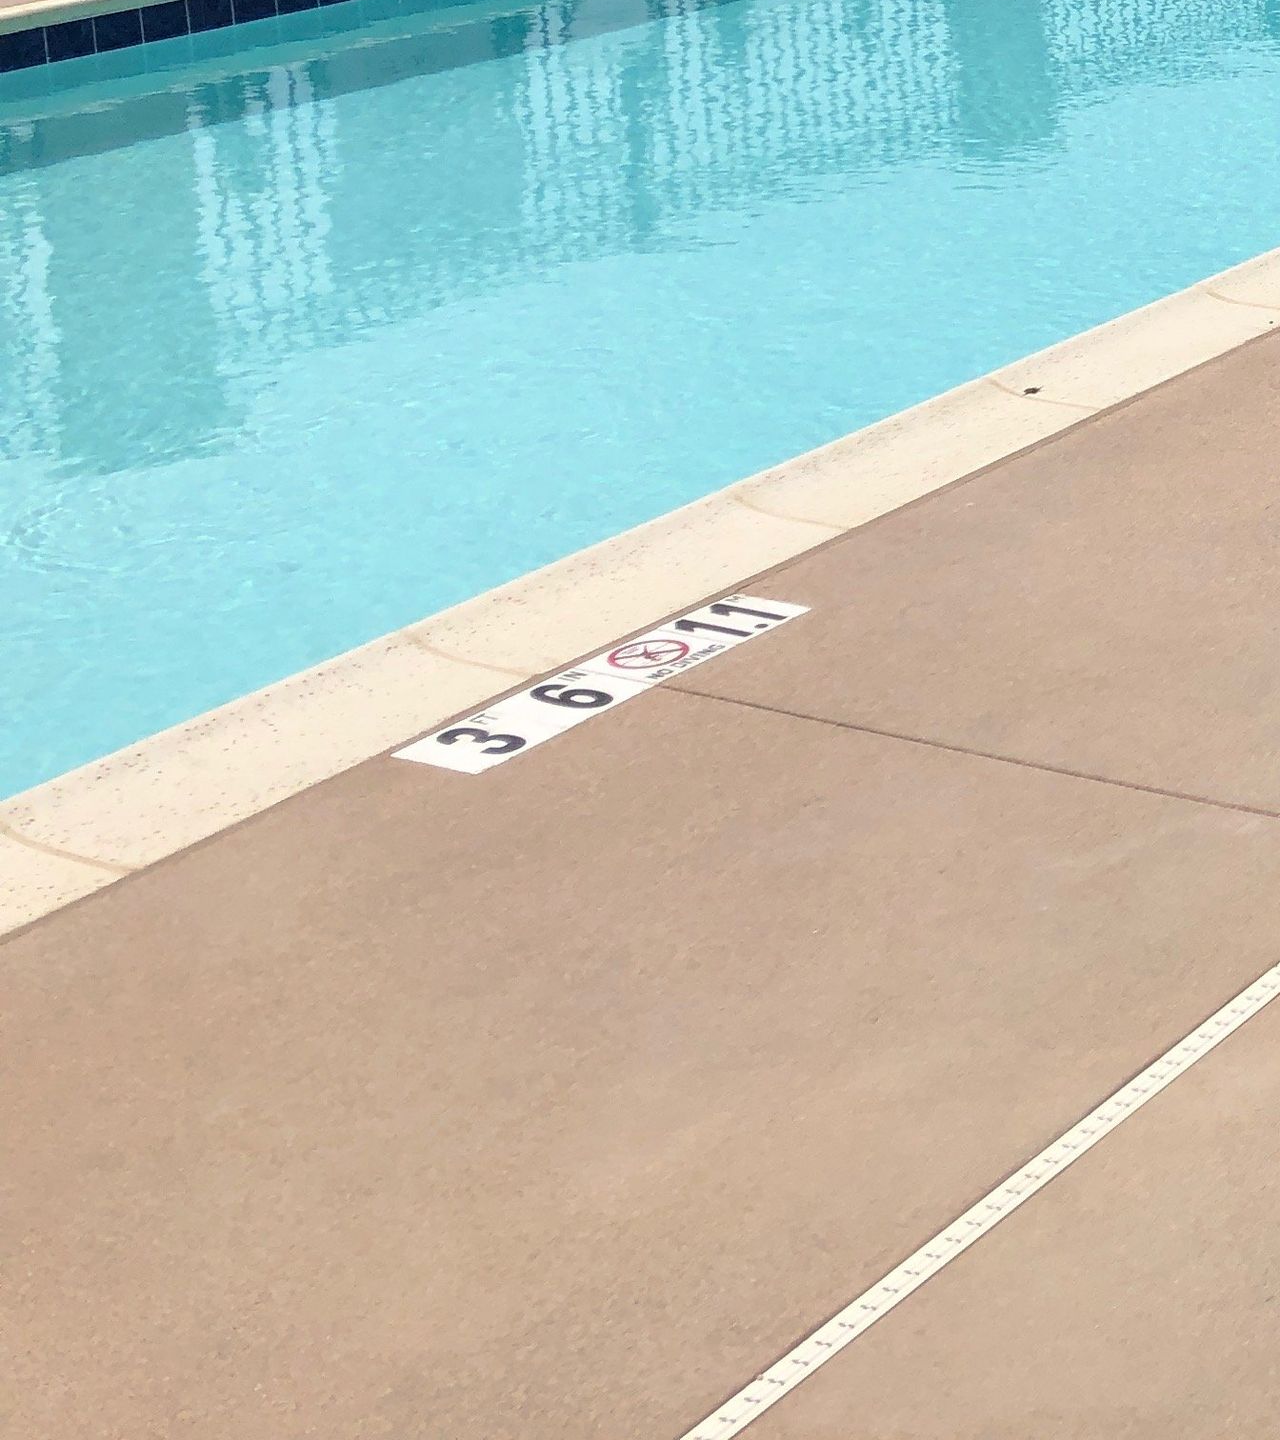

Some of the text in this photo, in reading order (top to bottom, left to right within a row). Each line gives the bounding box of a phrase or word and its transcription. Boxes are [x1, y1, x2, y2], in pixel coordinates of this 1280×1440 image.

[436, 727, 527, 755] 3
[529, 683, 614, 709] 6
[674, 602, 788, 638] 1.1
[646, 643, 726, 680] NO DIVING
